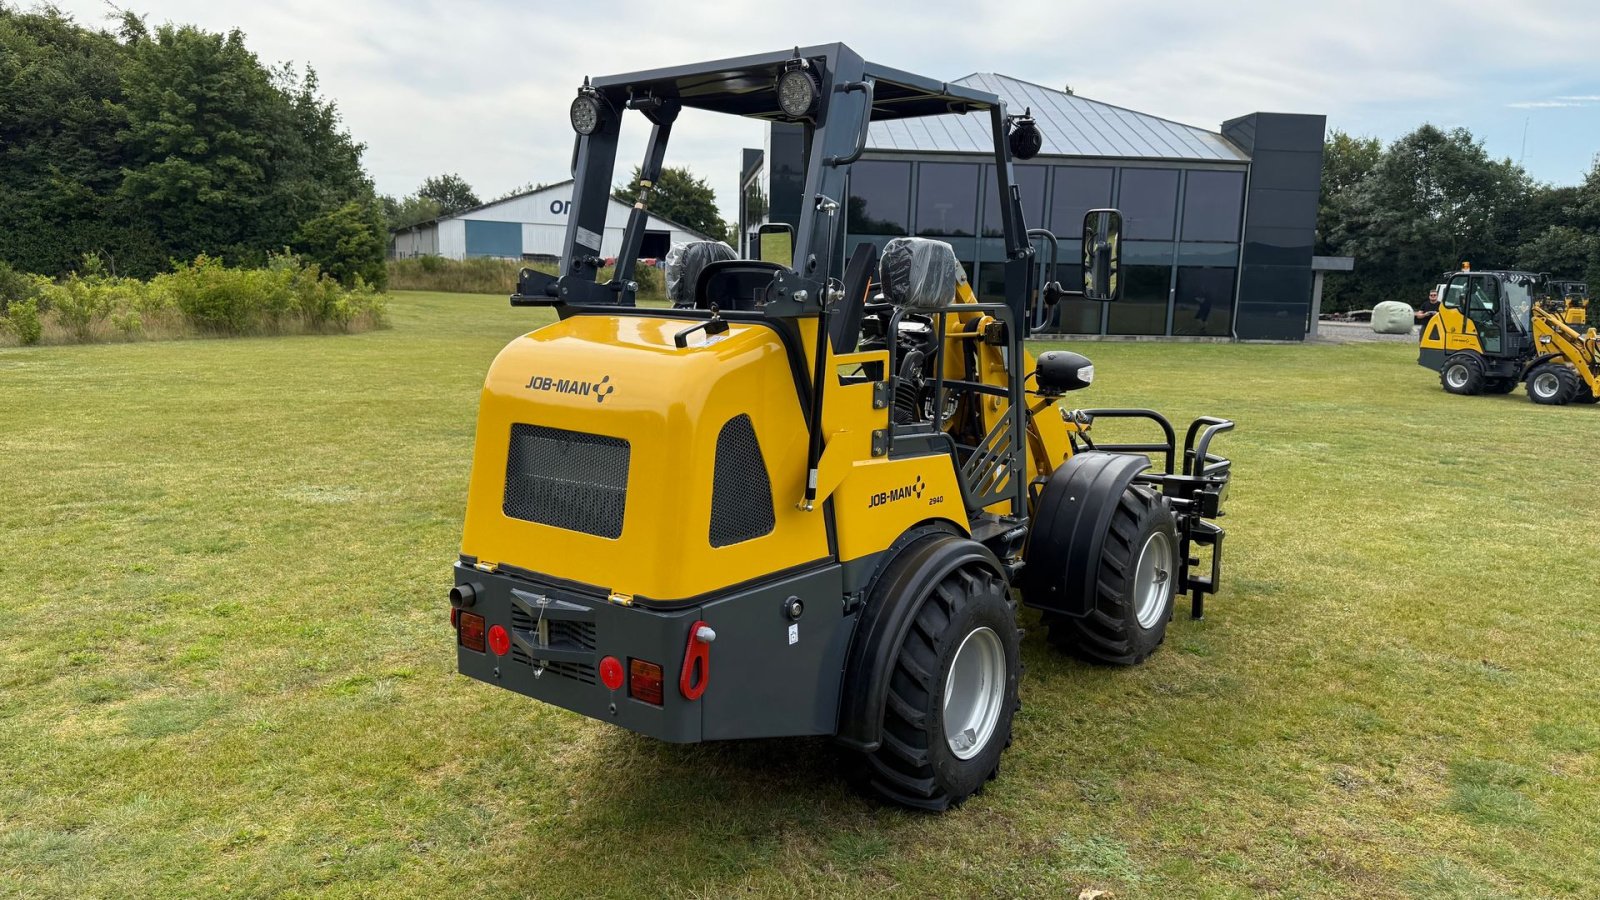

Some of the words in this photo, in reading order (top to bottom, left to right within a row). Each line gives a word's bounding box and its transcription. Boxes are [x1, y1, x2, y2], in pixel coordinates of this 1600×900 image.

[525, 376, 592, 396] JOB-MAN
[868, 485, 912, 508] JOB-MAN
[929, 495, 944, 505] 2940
